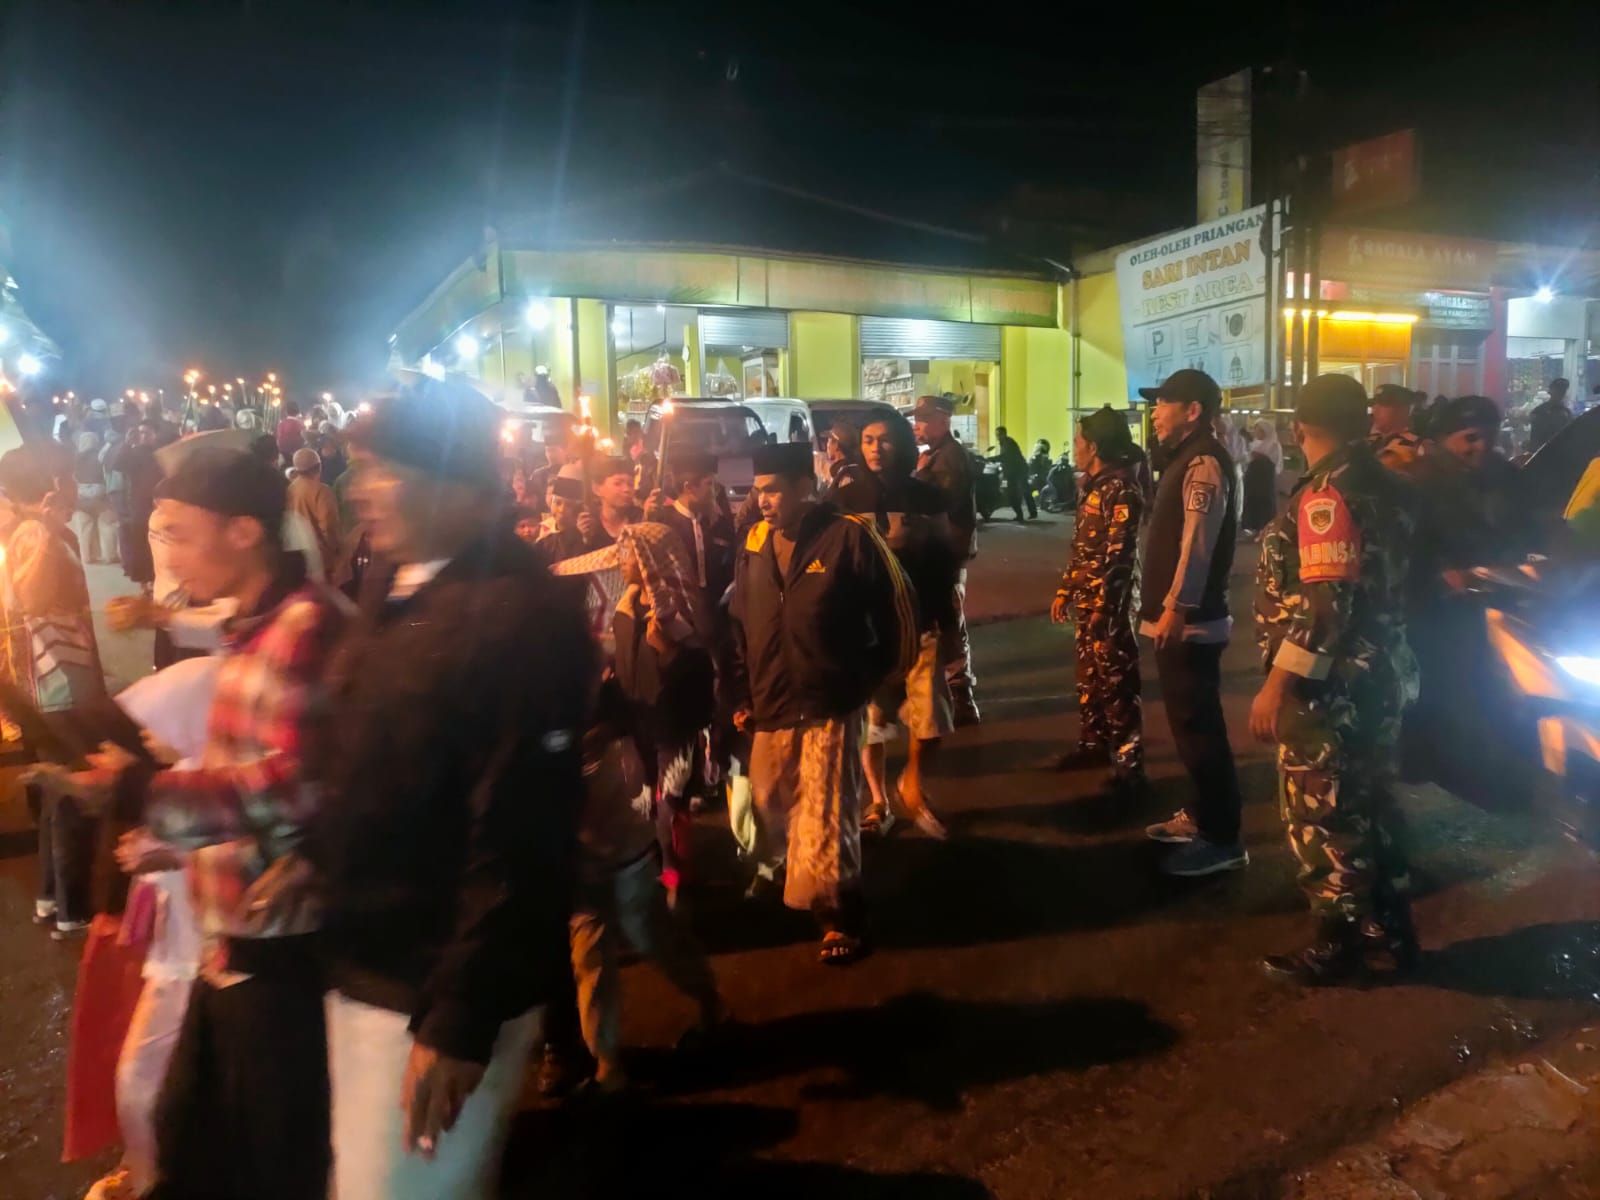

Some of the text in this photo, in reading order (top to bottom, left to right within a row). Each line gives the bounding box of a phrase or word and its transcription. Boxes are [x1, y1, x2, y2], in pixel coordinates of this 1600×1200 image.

[1130, 212, 1266, 266] OLEH-OLEH PRIANGAN
[1142, 239, 1251, 290] SARI INTAN
[1192, 273, 1253, 306] AREA
